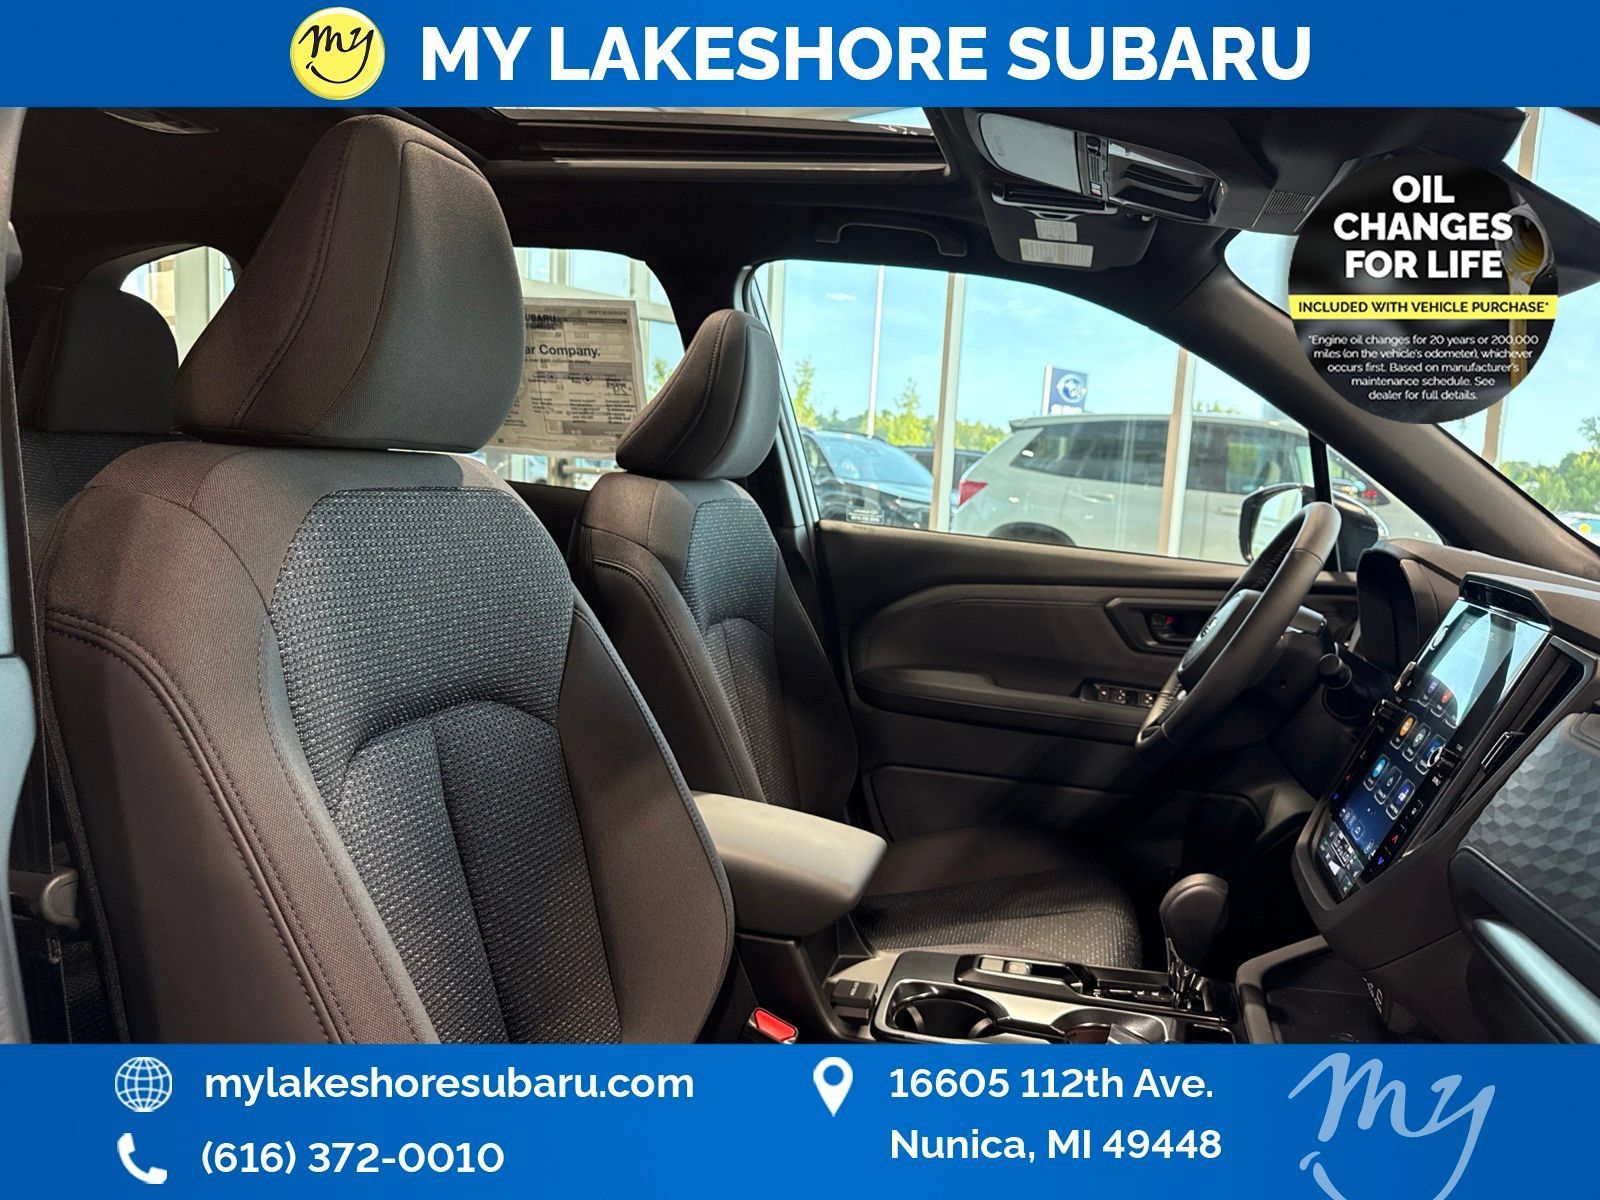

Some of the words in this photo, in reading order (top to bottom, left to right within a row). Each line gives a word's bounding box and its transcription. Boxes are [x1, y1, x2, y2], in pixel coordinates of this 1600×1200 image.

[525, 313, 556, 322] UBARU
[525, 347, 535, 355] ar
[539, 344, 601, 358] Company.
